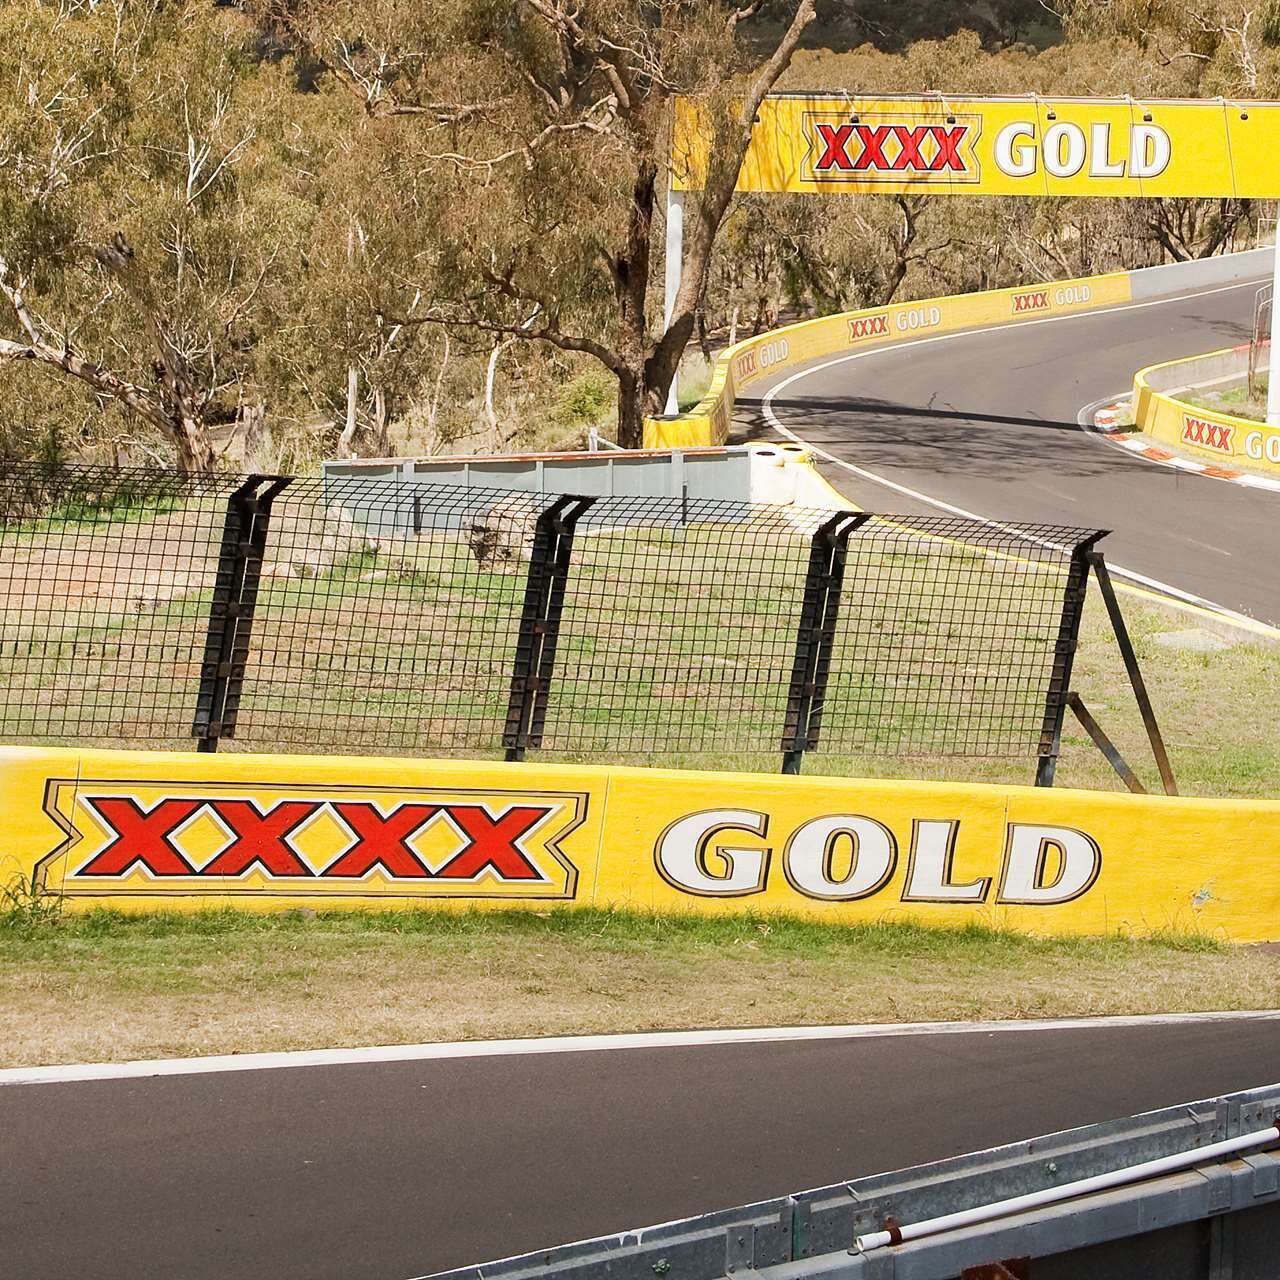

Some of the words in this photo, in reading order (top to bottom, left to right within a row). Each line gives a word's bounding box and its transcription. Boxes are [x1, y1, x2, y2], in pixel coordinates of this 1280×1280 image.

[814, 124, 970, 172] XXXX
[993, 121, 1172, 178] GOLD
[1014, 292, 1048, 311] XXXX
[1055, 284, 1091, 305] GOLD
[851, 317, 887, 339] XXXX
[896, 307, 941, 331] GOLD
[759, 338, 790, 368] GOLD
[1184, 417, 1232, 451] XXXX
[74, 796, 549, 884] XXXX
[653, 808, 1102, 906] GOLD
